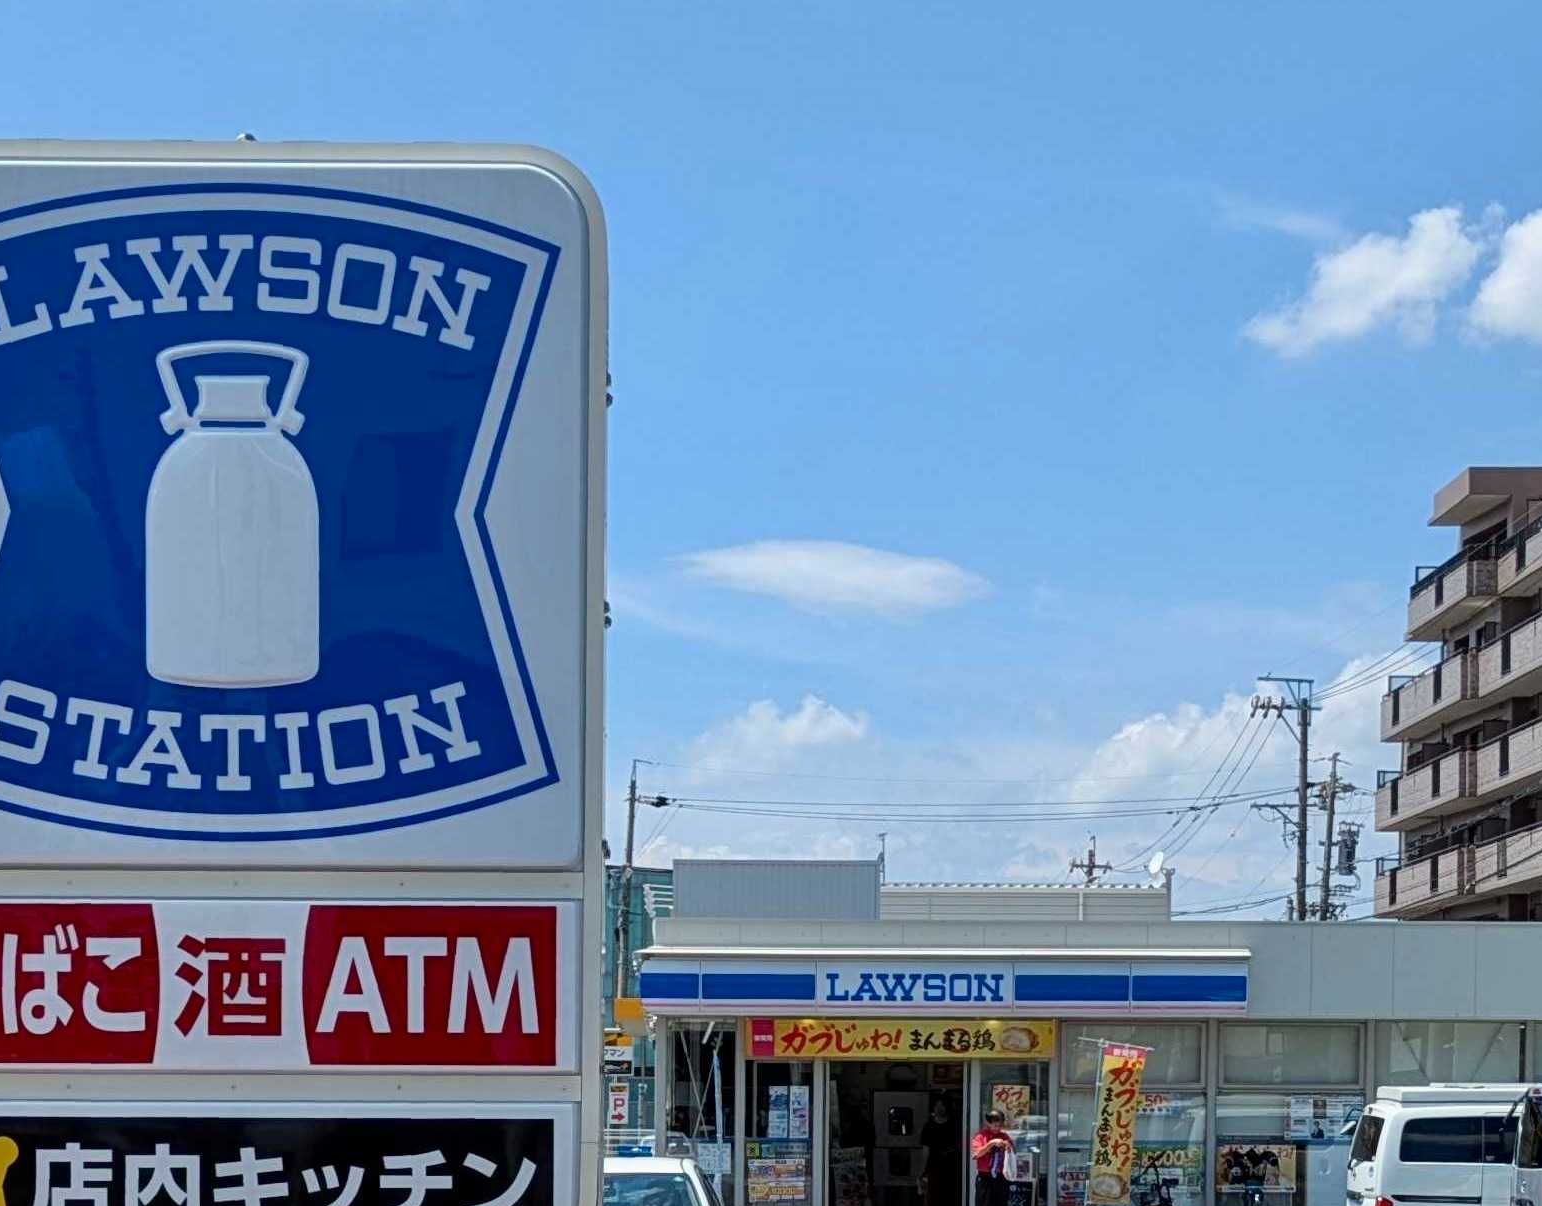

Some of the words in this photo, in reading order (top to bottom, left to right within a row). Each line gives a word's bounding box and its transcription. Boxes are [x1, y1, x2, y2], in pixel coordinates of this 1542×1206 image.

[174, 934, 287, 1037] 酒
[316, 937, 540, 1035] ATM
[826, 973, 1004, 1001] LAWSON
[613, 1098, 625, 1112] P
